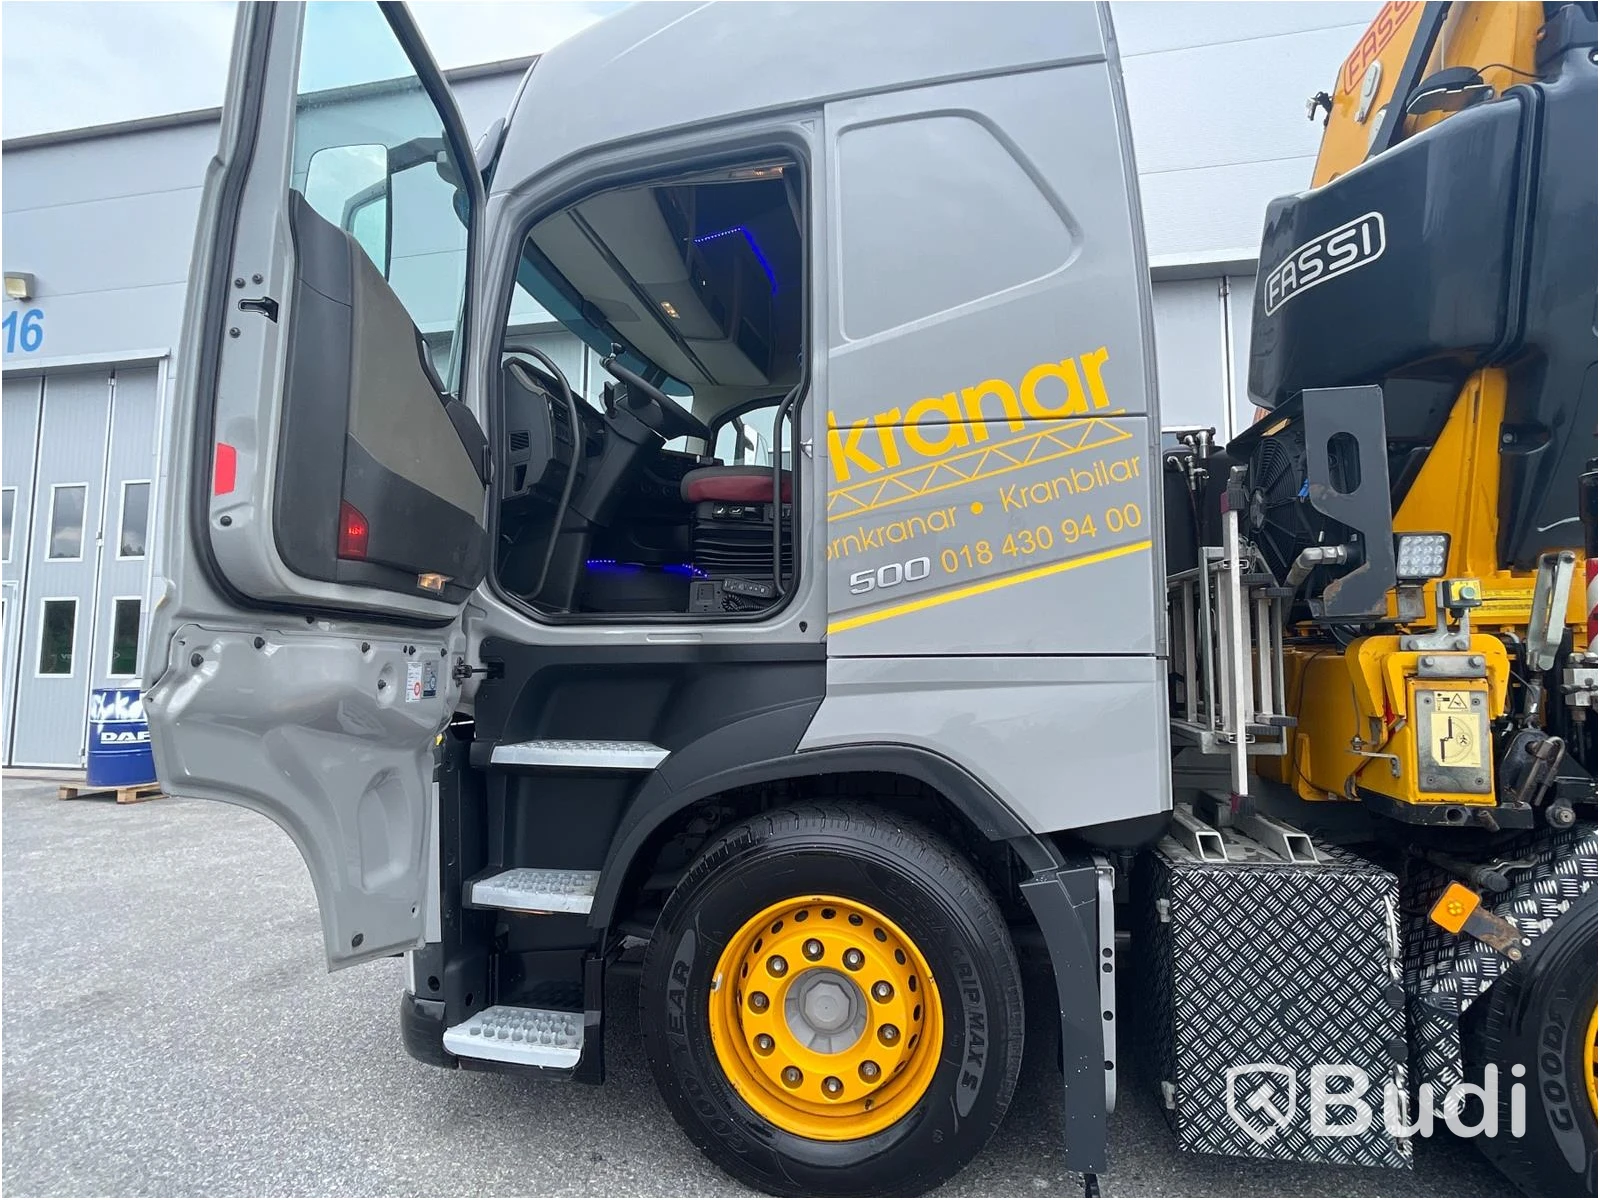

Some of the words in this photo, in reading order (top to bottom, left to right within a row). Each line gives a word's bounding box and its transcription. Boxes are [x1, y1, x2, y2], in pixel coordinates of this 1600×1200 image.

[1268, 222, 1371, 309] FASSI
[2, 308, 44, 353] 16
[827, 346, 1110, 483] kranar
[999, 456, 1140, 513] Kranbilar
[939, 540, 993, 573] 018
[1002, 525, 1054, 557] 430
[1061, 514, 1097, 544] 94
[1105, 503, 1142, 533] 00
[849, 556, 931, 595] 500
[101, 731, 151, 742] DAF
